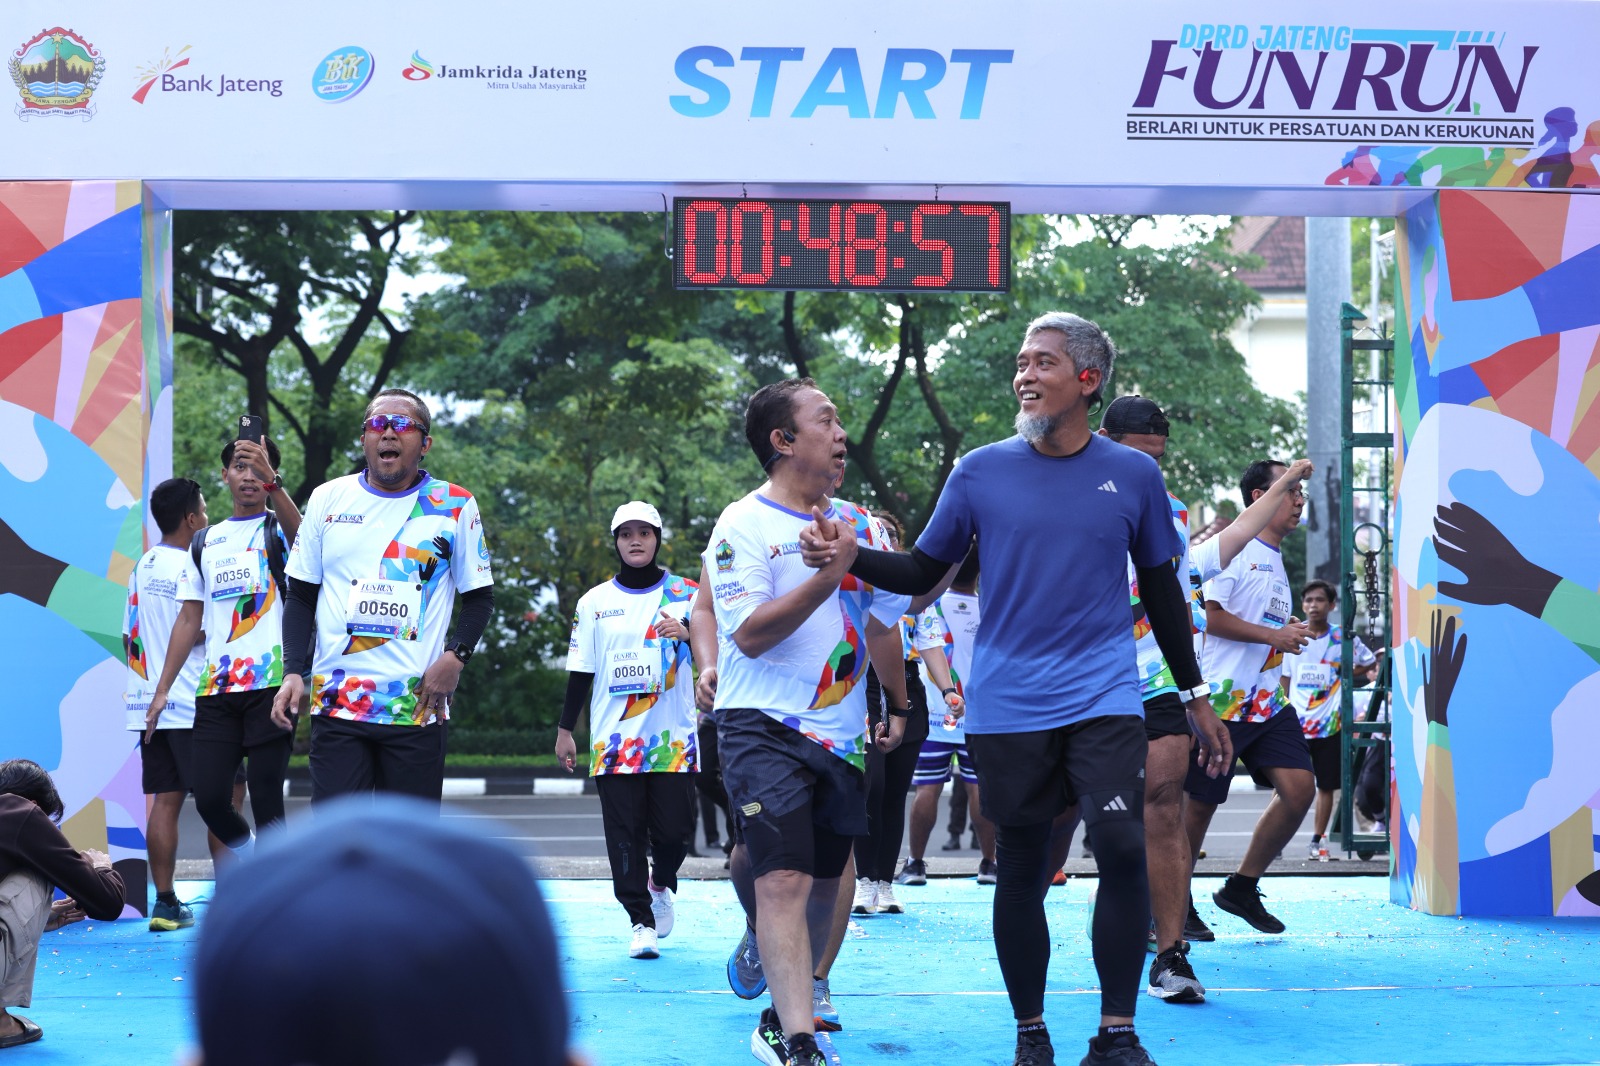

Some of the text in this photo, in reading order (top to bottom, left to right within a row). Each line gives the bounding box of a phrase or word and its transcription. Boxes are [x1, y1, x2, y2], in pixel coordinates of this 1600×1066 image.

[1178, 23, 1351, 51] DPRD JATENG
[437, 64, 588, 83] Jamkrida Jateng
[669, 45, 1015, 120] START
[1131, 39, 1540, 114] FUN RUN
[161, 73, 283, 97] Bank Jateng
[486, 81, 586, 92] Mitra Usaha Masyarakat
[1126, 120, 1534, 139] BERLARI UNTUK PERSATUAN DAN KERUKUNAN
[684, 200, 1000, 288] 00:48:57
[216, 568, 250, 584] 00356
[359, 600, 408, 618] 00560
[614, 664, 651, 679] 00801
[1107, 1025, 1135, 1034] Reebo
